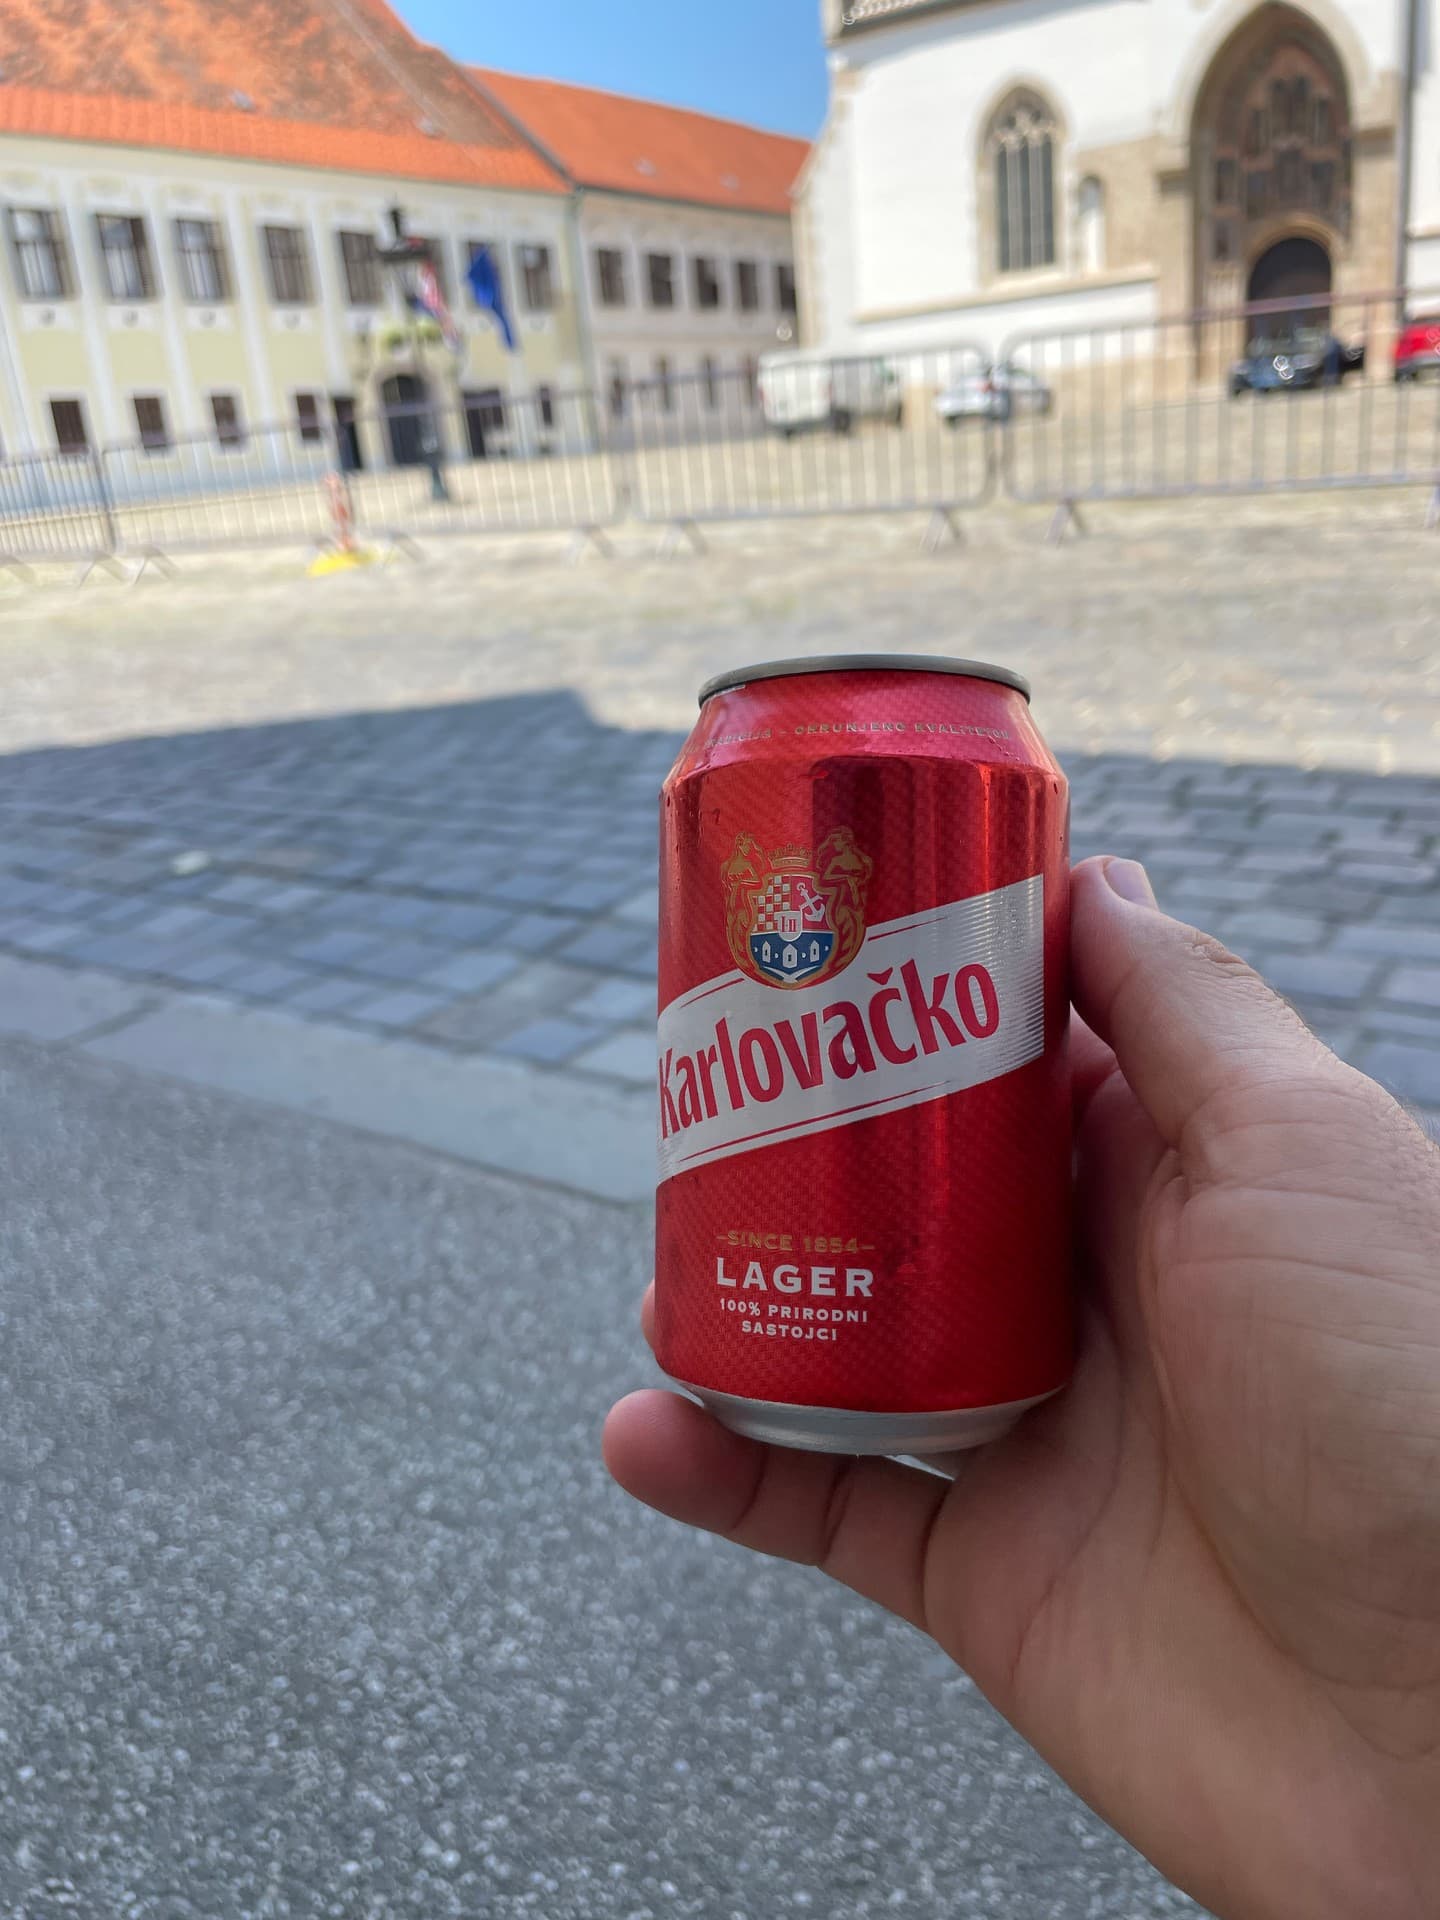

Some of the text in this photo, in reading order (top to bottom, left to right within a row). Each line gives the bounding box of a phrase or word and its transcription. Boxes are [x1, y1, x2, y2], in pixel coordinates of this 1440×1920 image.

[658, 958, 1001, 1140] Karlovačko
[727, 1230, 858, 1254] SINCE 1854
[716, 1256, 875, 1298] LAGER
[719, 1298, 869, 1323] 100% PRIRODNI
[741, 1320, 838, 1341] SASTOJCI
